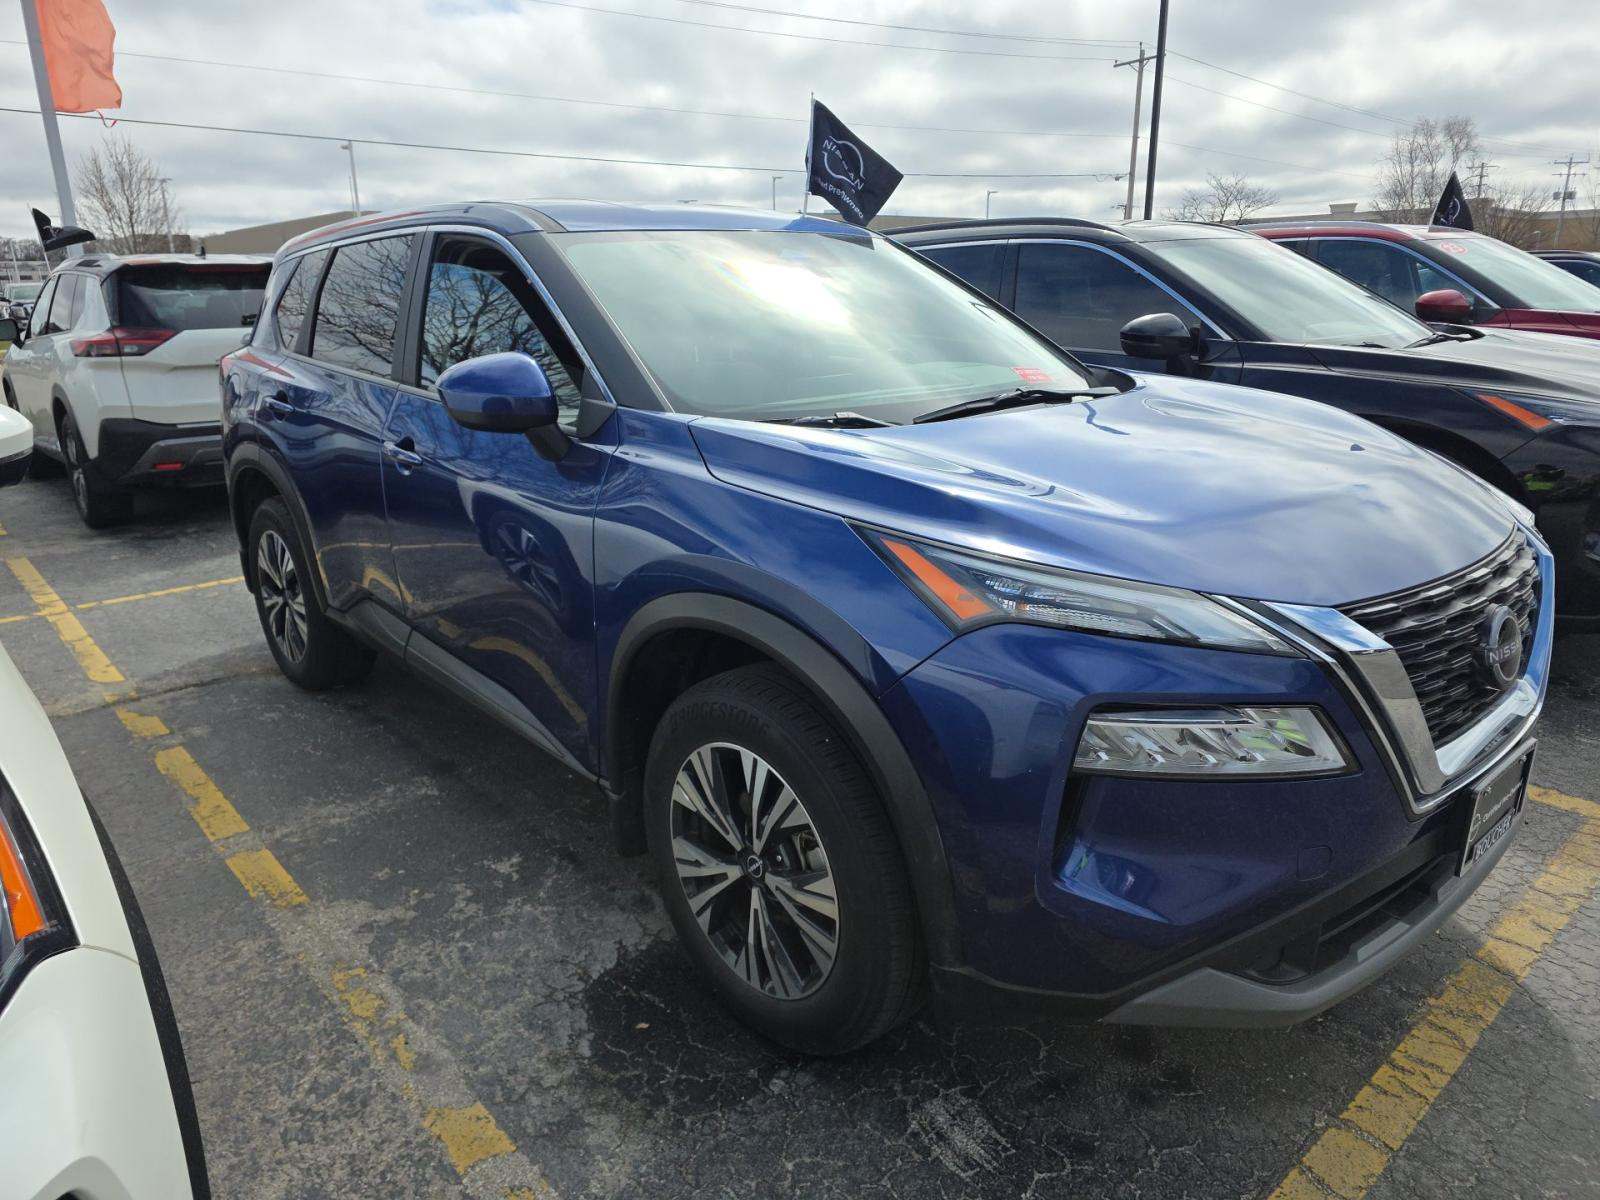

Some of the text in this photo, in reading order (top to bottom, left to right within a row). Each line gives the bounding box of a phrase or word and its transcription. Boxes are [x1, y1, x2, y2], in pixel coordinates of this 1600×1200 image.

[822, 139, 865, 190] NIAN
[1489, 640, 1519, 663] NISS
[1475, 814, 1513, 860] BOUCHER
